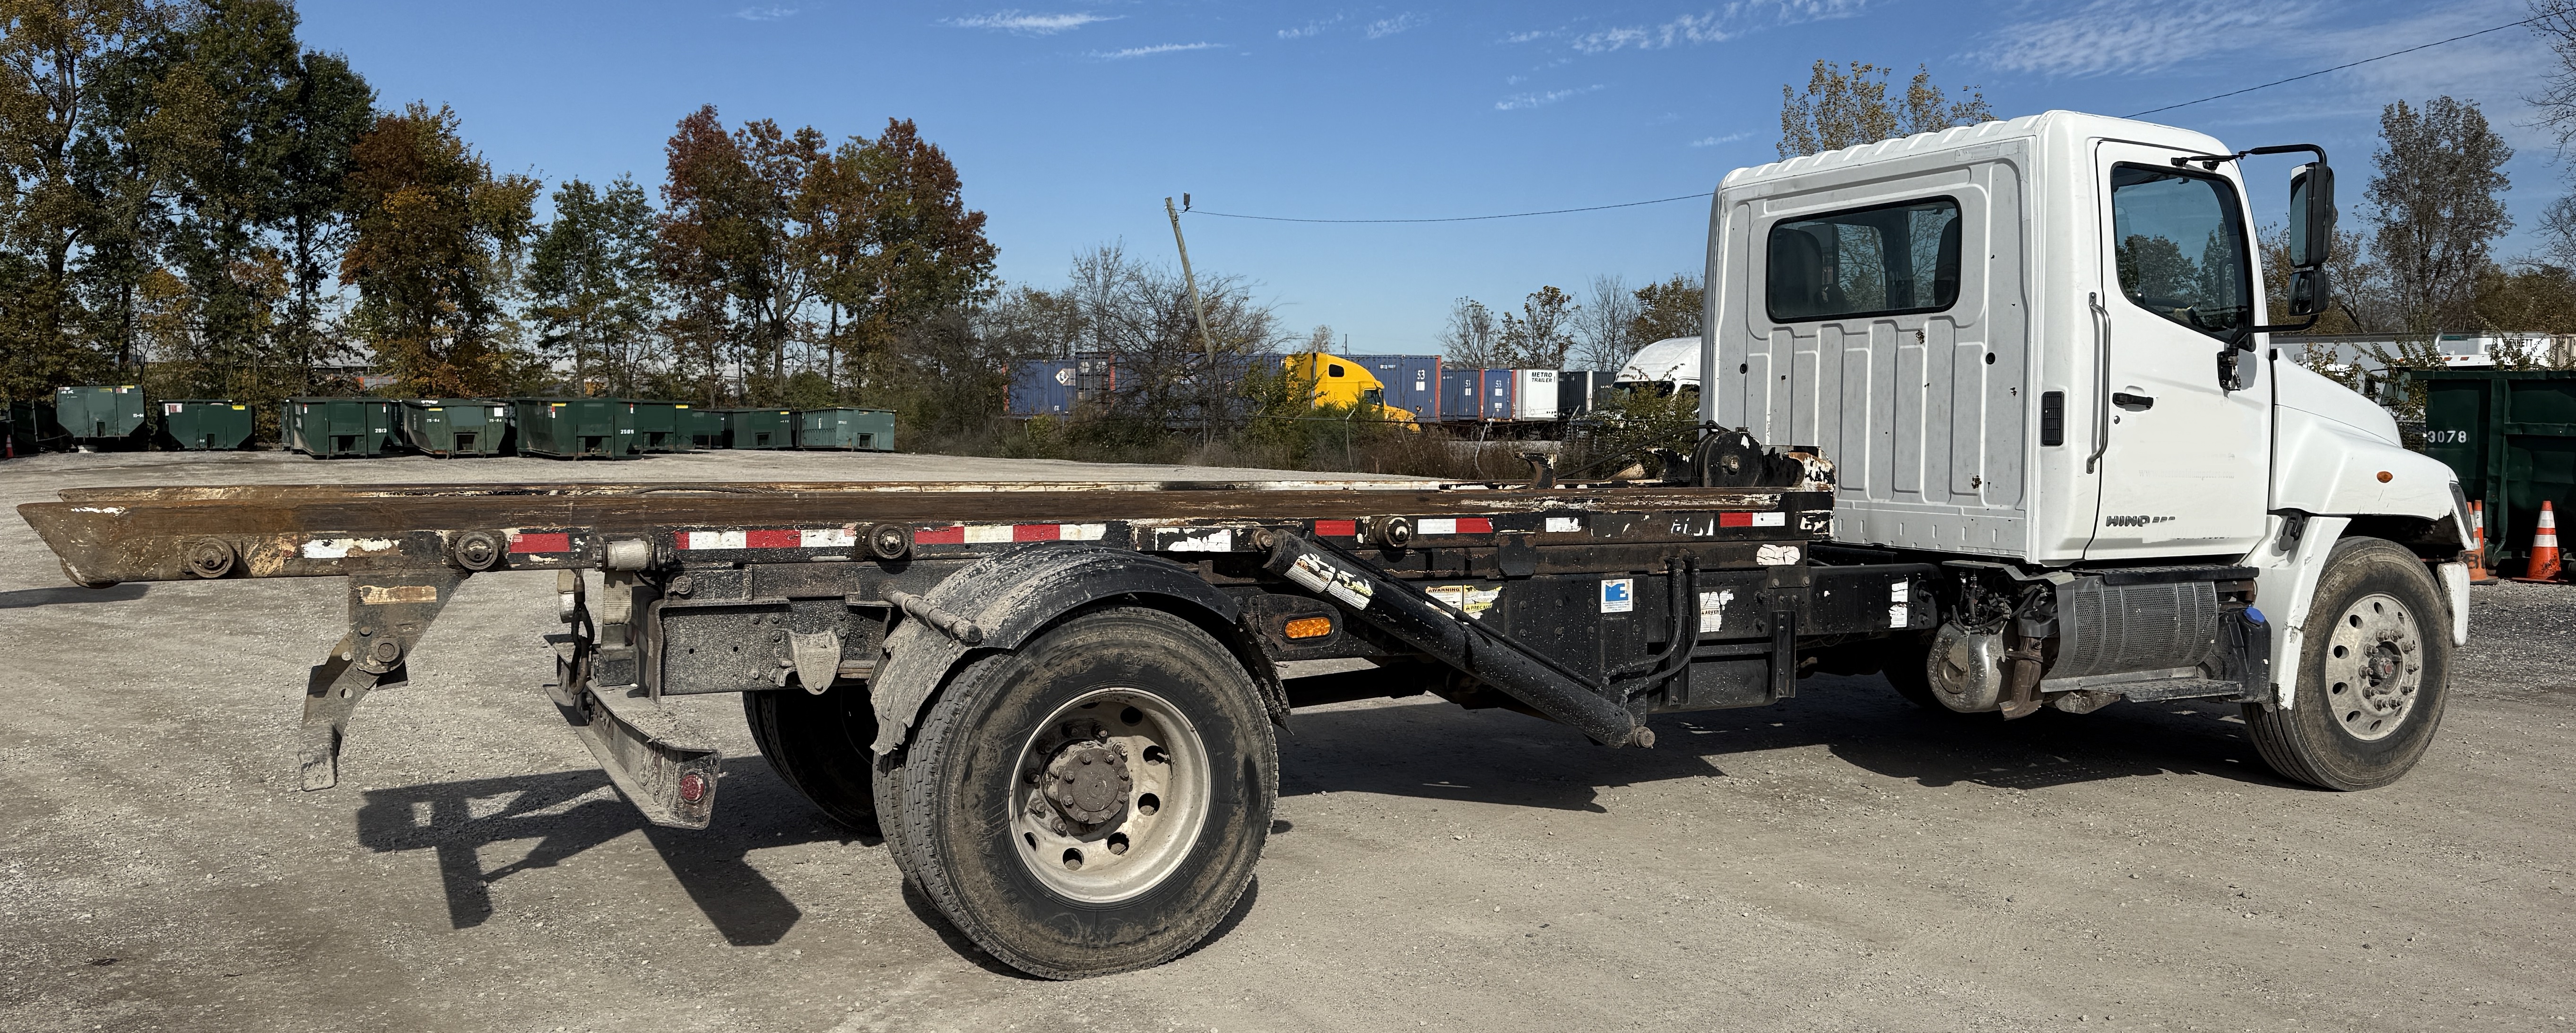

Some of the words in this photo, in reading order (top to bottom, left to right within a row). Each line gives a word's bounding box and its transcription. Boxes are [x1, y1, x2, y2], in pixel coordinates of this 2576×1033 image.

[1417, 369, 1425, 380] 53
[2428, 431, 2466, 443] 3078
[2106, 516, 2150, 527] HINO
